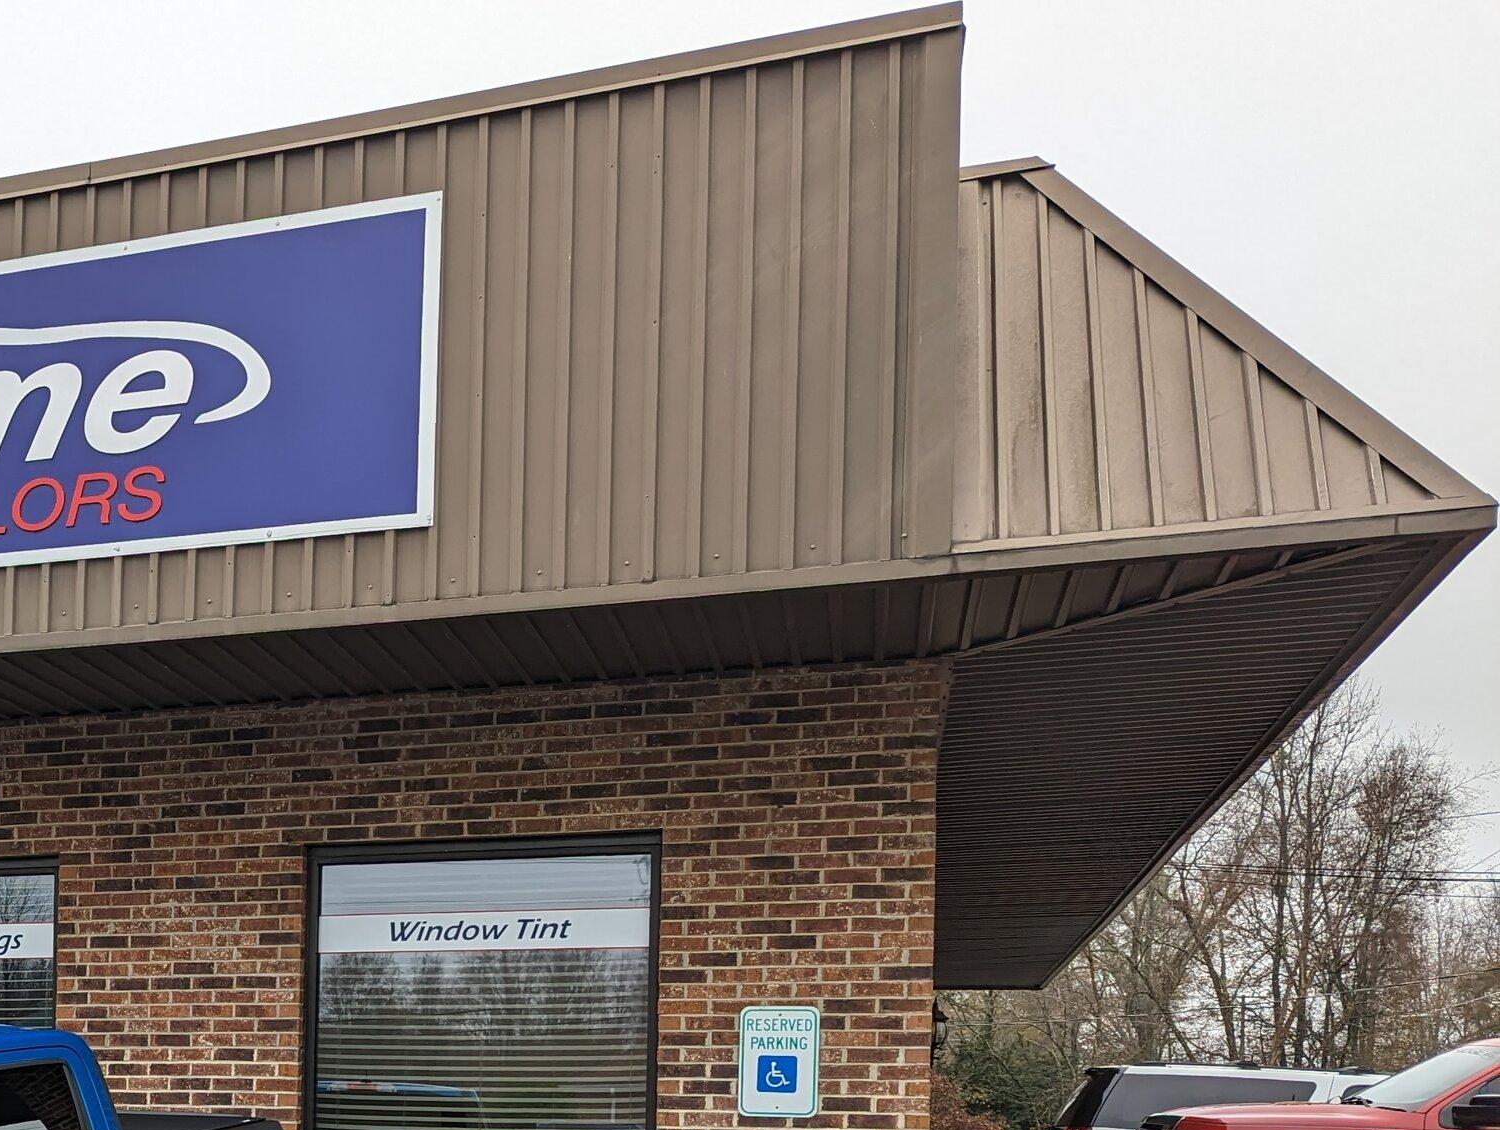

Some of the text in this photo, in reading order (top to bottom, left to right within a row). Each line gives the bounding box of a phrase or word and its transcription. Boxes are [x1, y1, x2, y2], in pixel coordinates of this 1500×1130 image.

[390, 918, 572, 942] Window Tint
[746, 1018, 813, 1032] RESERVED
[750, 1036, 808, 1050] PARKING
